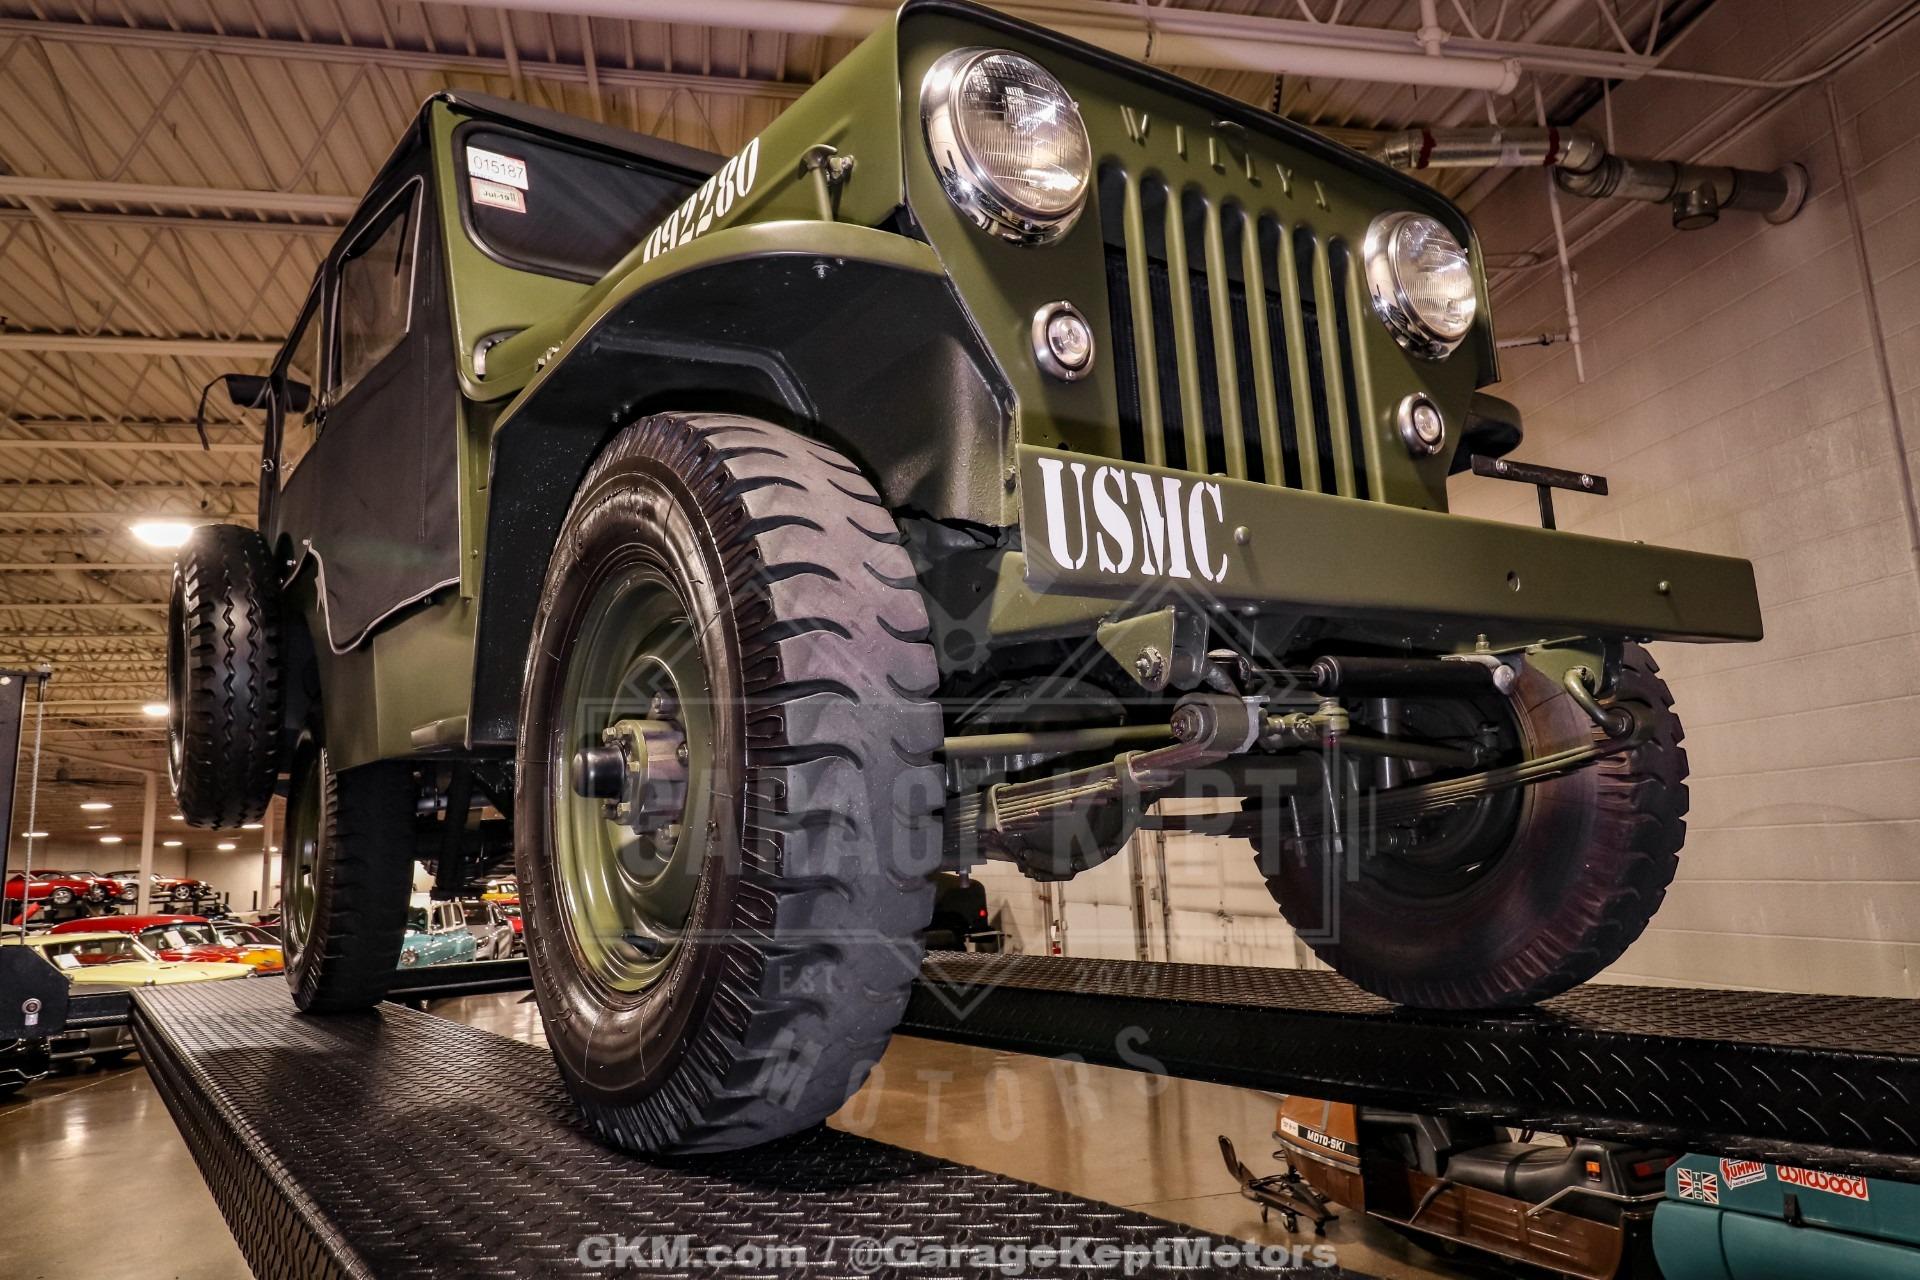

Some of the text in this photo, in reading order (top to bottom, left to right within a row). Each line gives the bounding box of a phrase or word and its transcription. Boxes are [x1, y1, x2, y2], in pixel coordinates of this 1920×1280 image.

[473, 155, 524, 179] 015187
[643, 136, 759, 264] 092280
[1037, 457, 1228, 584] USMC
